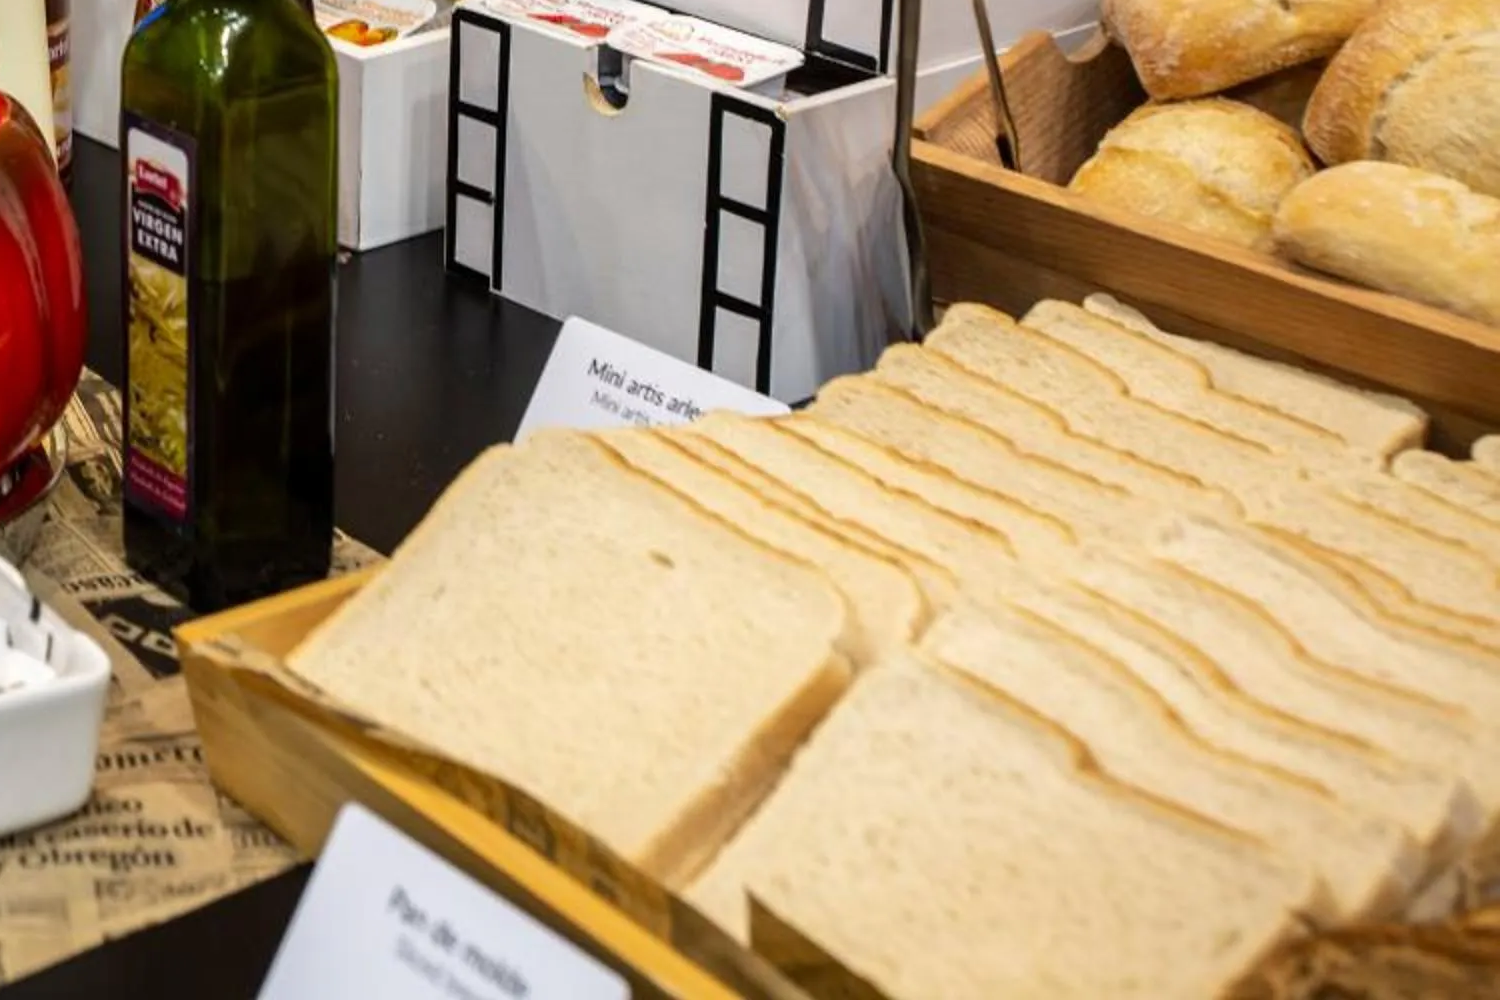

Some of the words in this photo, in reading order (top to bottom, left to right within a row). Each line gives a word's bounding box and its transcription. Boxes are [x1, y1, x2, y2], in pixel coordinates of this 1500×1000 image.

[132, 206, 183, 246] VIRGEN
[137, 228, 179, 263] EXTRA
[586, 357, 628, 389] Mini
